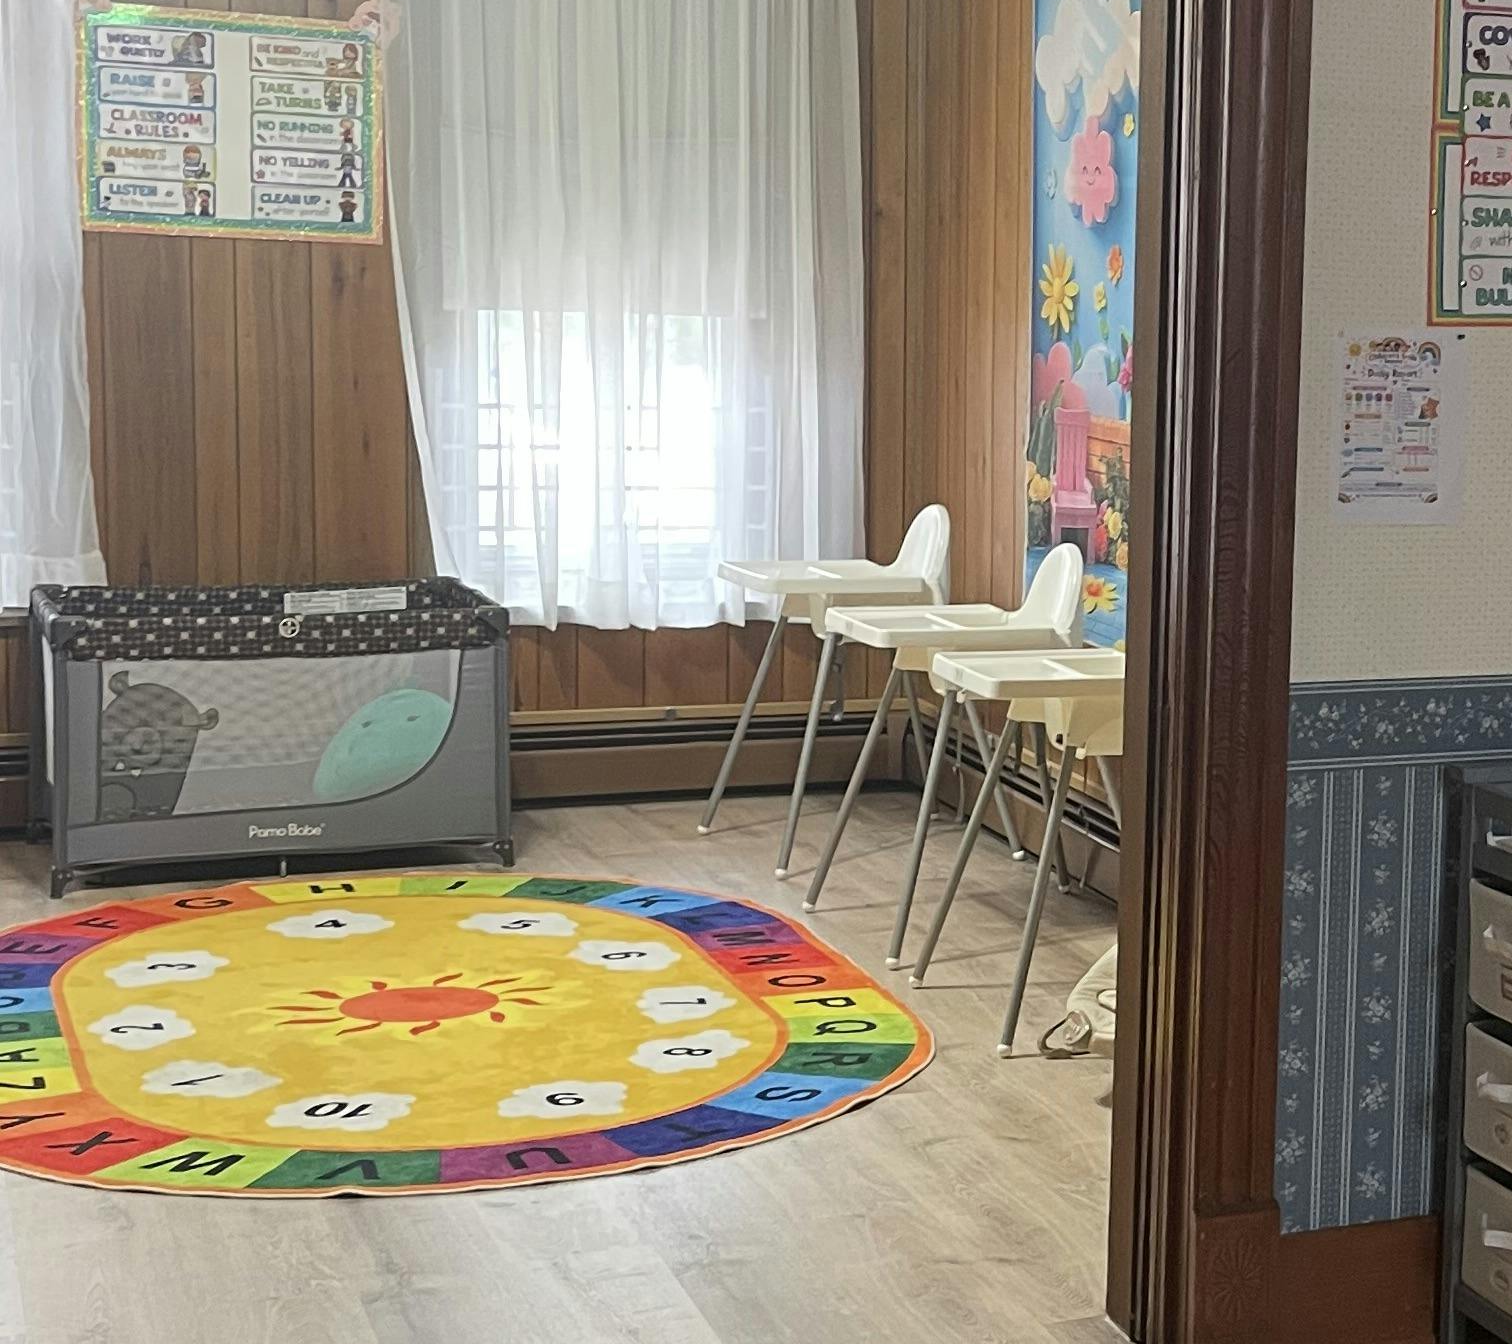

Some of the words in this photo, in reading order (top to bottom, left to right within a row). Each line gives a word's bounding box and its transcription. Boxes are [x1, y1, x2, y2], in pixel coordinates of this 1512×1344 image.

[258, 81, 294, 95] TAKE
[1473, 90, 1494, 108] BE
[1497, 91, 1511, 109] A
[110, 108, 203, 127] CLASSROOM
[134, 124, 179, 139] RULES
[257, 119, 276, 132] NO
[258, 155, 277, 167] NO
[108, 182, 158, 198] LISTEN
[309, 883, 356, 894] H
[174, 896, 233, 909] G
[75, 917, 119, 929] F
[315, 919, 347, 928] 4
[501, 919, 541, 930] 5
[712, 931, 775, 946] M
[0, 941, 68, 955] E
[601, 951, 646, 961] 6
[740, 953, 801, 966] N
[147, 962, 196, 971] 3
[768, 974, 826, 987] O
[659, 997, 707, 1006] 7
[794, 996, 857, 1008] P
[110, 1022, 165, 1034] 2
[812, 1019, 877, 1036] Q
[663, 1047, 712, 1057] 8
[802, 1052, 869, 1067] R
[171, 1074, 223, 1086] 1
[755, 1086, 822, 1102] S
[304, 1101, 373, 1119] 10
[46, 1131, 139, 1155] X
[138, 1151, 246, 1176] W
[506, 1146, 572, 1170] U
[315, 1159, 382, 1181] V
